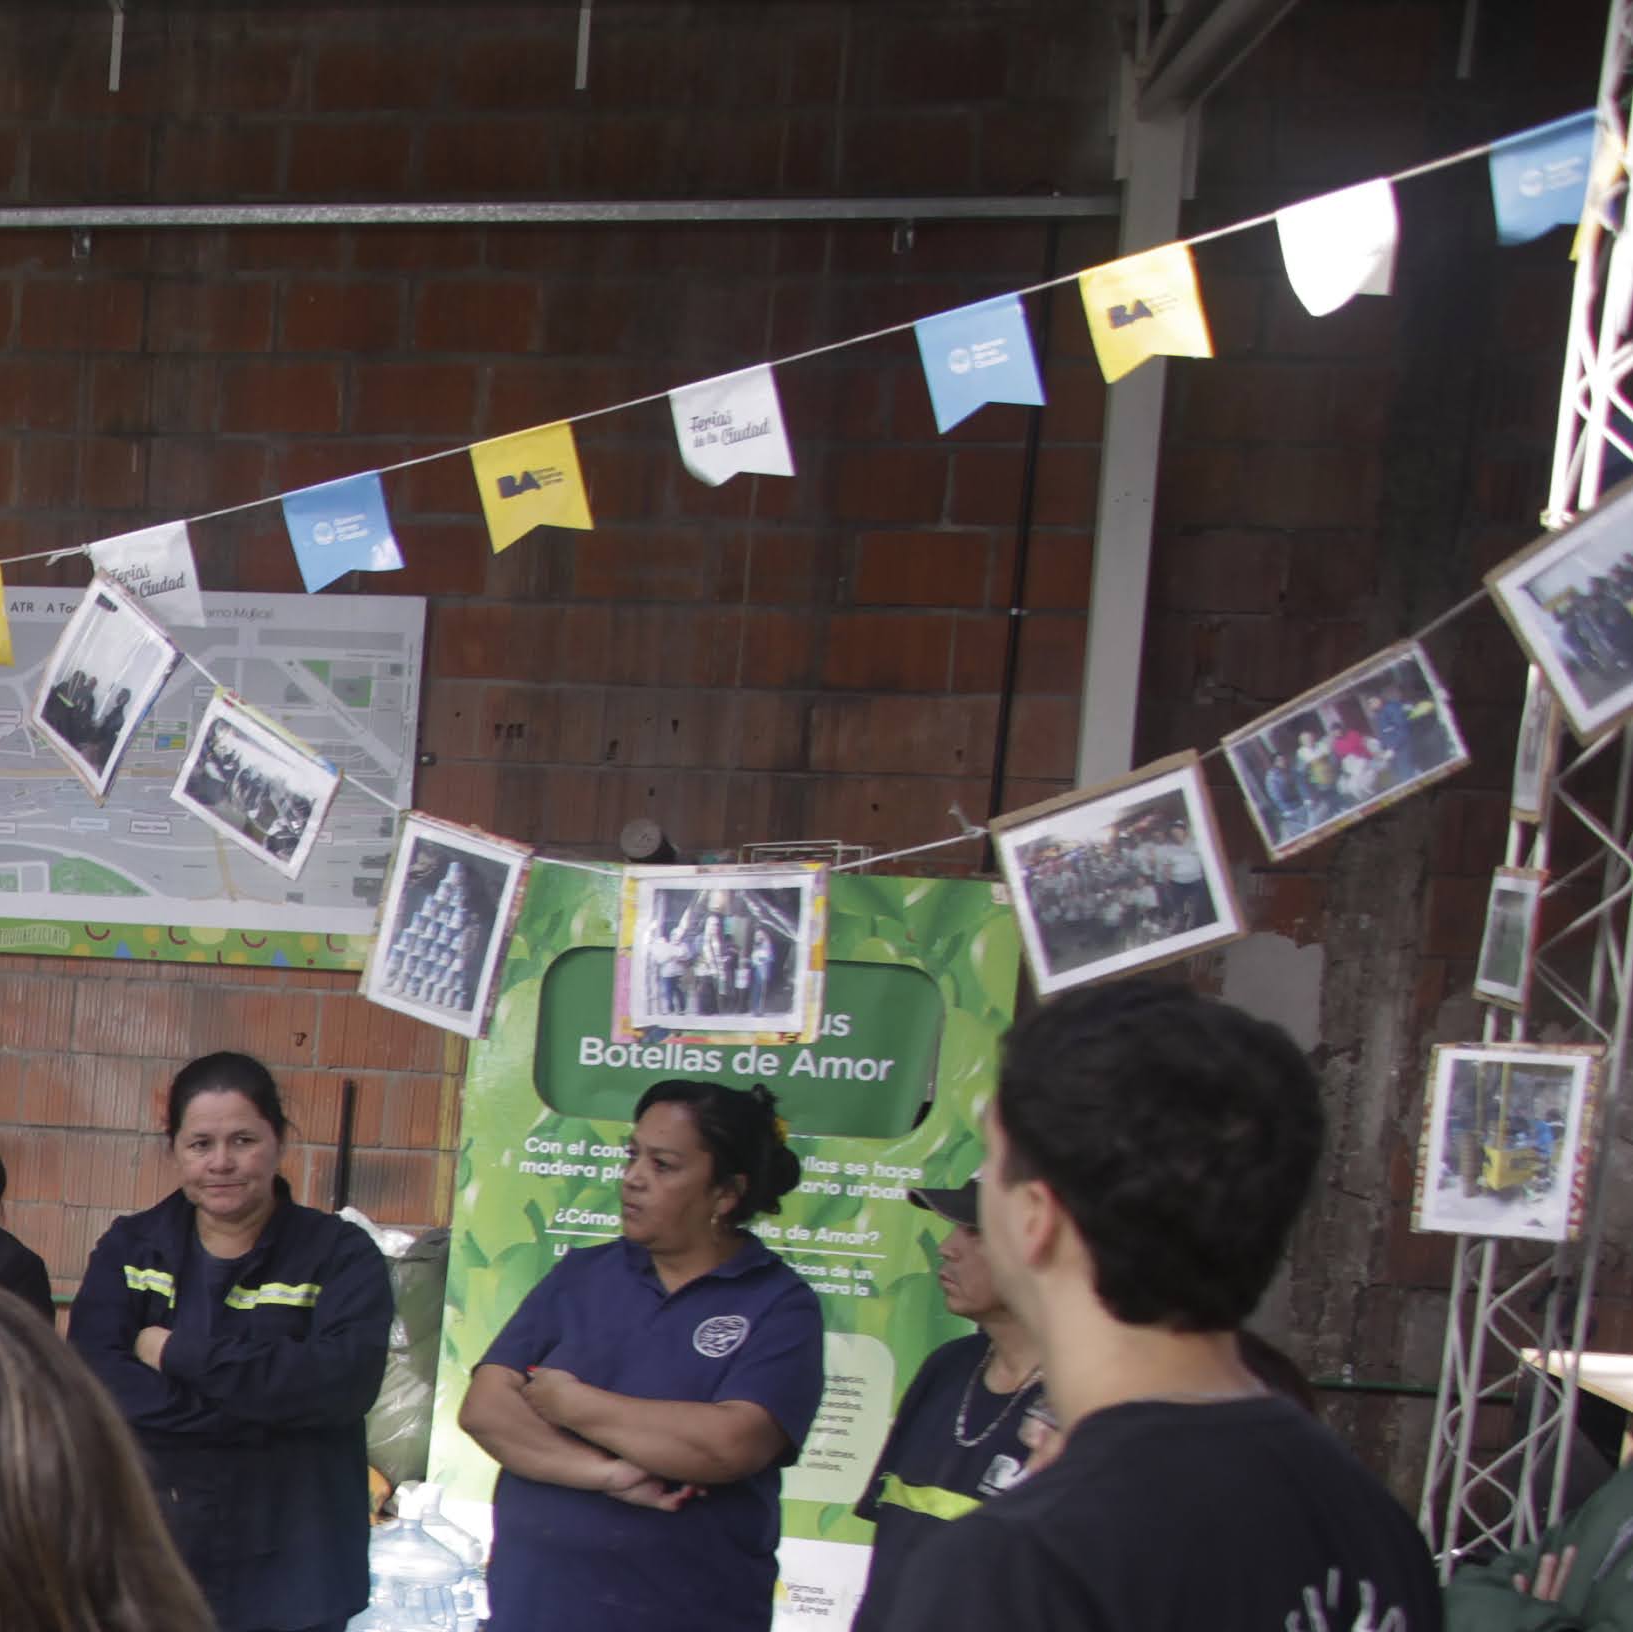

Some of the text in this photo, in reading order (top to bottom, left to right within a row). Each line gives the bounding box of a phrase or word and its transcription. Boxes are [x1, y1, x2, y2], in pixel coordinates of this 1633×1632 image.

[721, 417, 771, 446] Ciudad
[497, 471, 541, 499] BA
[139, 571, 186, 598] Ciudad
[10, 601, 34, 613] ATR
[578, 1037, 895, 1081] Botellas de Amor
[525, 1137, 561, 1155] Con
[567, 1141, 586, 1156] el
[519, 1159, 597, 1179] madera
[844, 1161, 870, 1177] se
[873, 1160, 923, 1181] hace
[785, 1224, 809, 1241] de
[813, 1226, 880, 1247] Amor?
[830, 1264, 851, 1279] de
[853, 1267, 876, 1280] un
[853, 1282, 871, 1297] la
